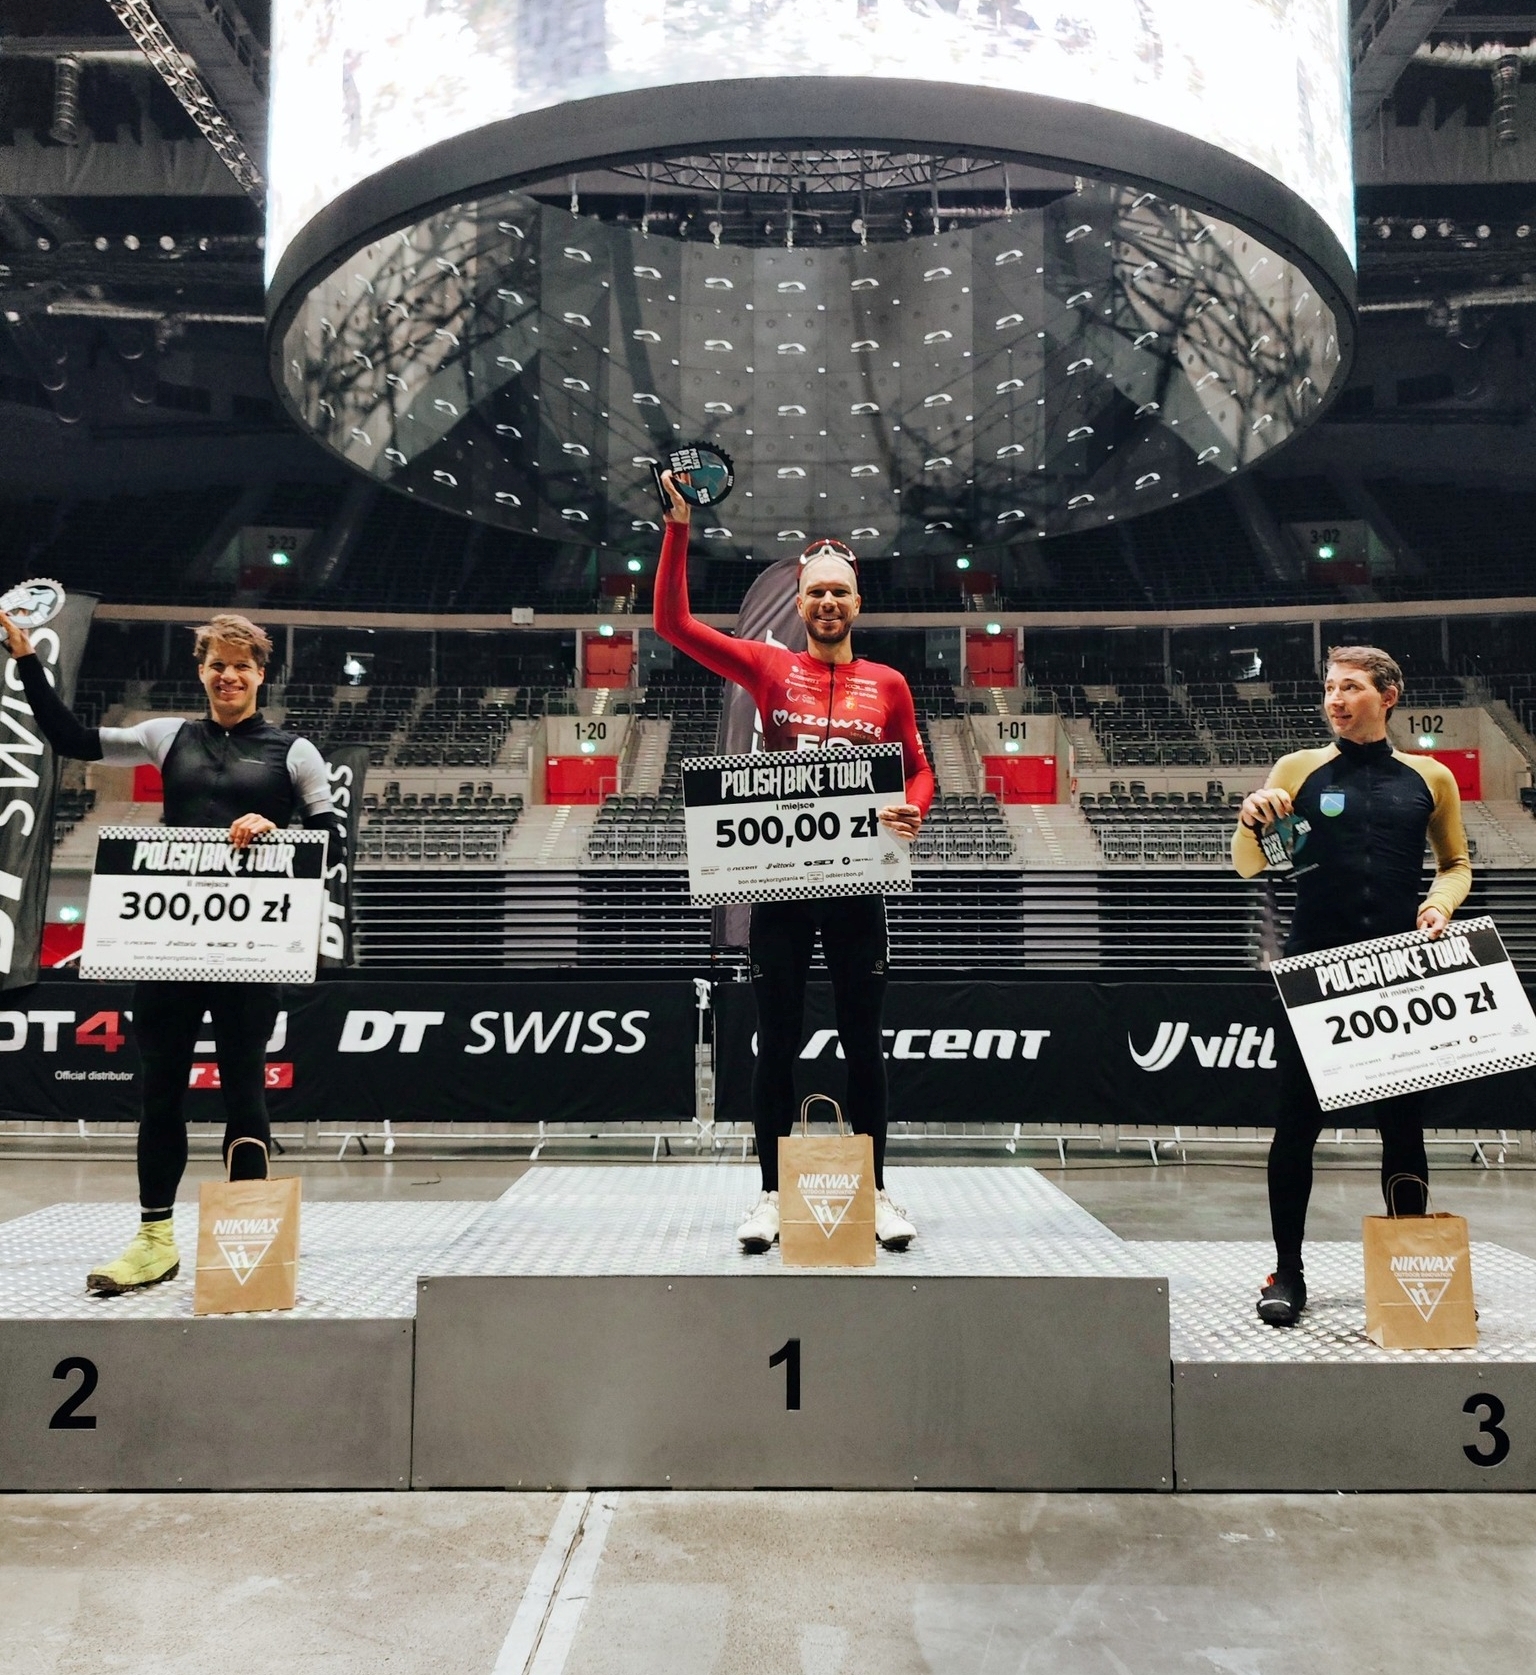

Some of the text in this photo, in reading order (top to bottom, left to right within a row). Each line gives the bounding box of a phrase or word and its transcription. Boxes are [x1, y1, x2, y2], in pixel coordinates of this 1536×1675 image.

[669, 451, 683, 473] TOUR
[678, 449, 695, 471] BIKE
[1310, 529, 1340, 544] 3-02
[574, 722, 607, 740] 1-20
[997, 721, 1027, 740] 1-01
[1407, 715, 1444, 734] 1-02
[720, 758, 876, 800] POLISH BIKE TOUR
[781, 801, 815, 812] miejsce
[324, 762, 354, 884] SISS
[716, 807, 880, 849] 500,00 zł
[132, 841, 296, 878] POLISH BIKE TOUR
[195, 880, 230, 888] miejsce
[758, 876, 798, 884] wykorzystania
[825, 871, 864, 879] odbierzbon.pl
[119, 892, 292, 926] 300,00 zł
[1314, 935, 1482, 997] POLISH BIKE TOUR
[1390, 984, 1426, 998] miejsce
[1324, 981, 1498, 1045] 200,00 zł
[337, 1009, 650, 1055] DT SWISS
[55, 1070, 135, 1081] Official distributor
[797, 1173, 860, 1189] NIKWAX
[213, 1218, 281, 1235] NIKWAX
[1390, 1256, 1456, 1272] NIKWAX
[769, 1338, 801, 1410] 1
[49, 1356, 99, 1430] 2
[1462, 1392, 1510, 1467] 3
